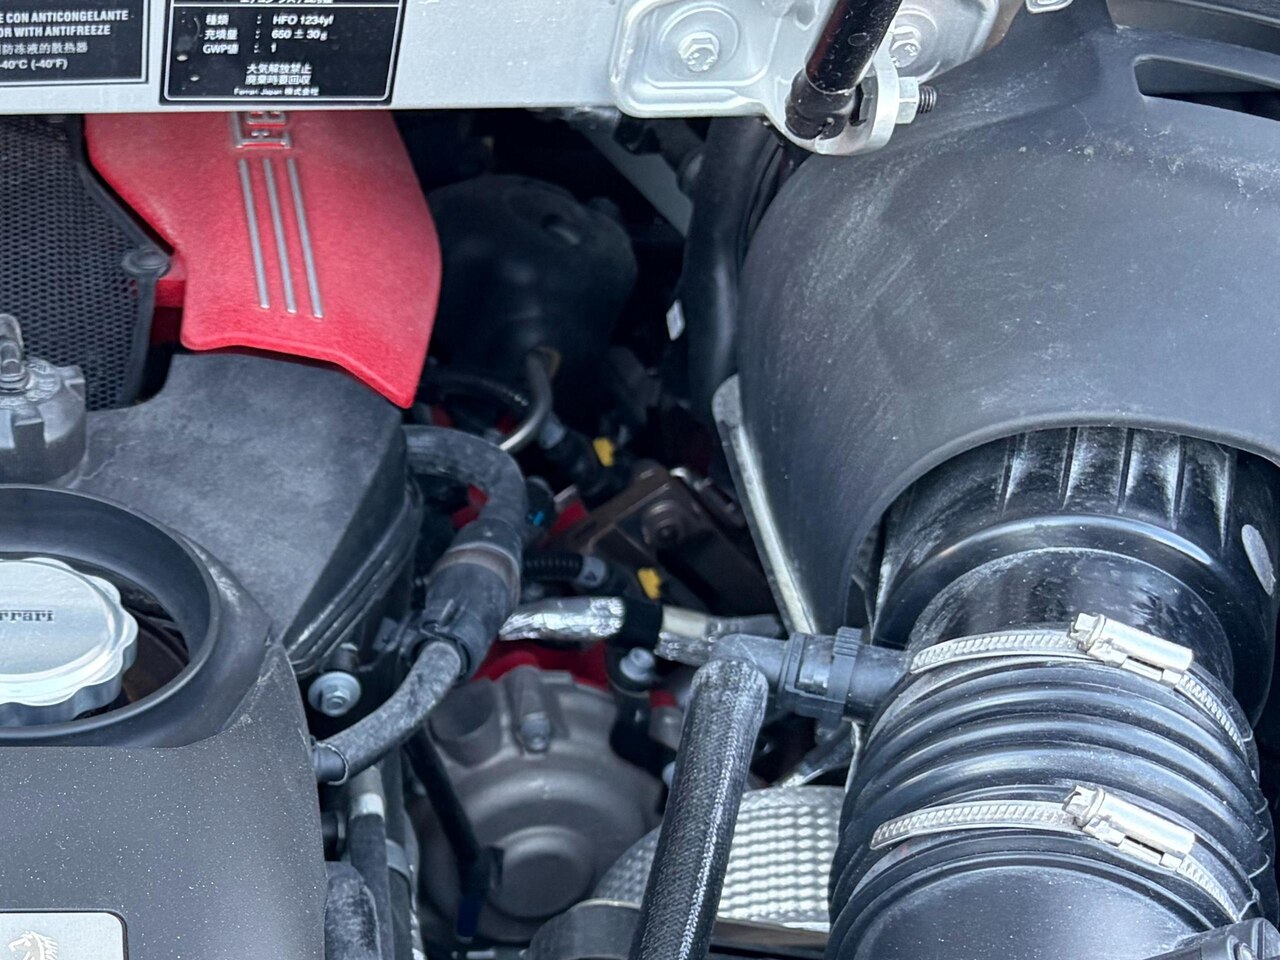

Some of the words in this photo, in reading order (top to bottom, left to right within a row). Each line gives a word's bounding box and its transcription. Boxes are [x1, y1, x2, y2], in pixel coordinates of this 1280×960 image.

[6, 12, 29, 24] CON
[31, 9, 129, 24] ANTICONGELANTE
[272, 15, 298, 25] HFO
[300, 14, 335, 27] 1234yf
[14, 25, 43, 38] WITH
[44, 24, 111, 37] ANTIFREEZE
[271, 30, 292, 40] 650
[306, 30, 328, 41] 30g
